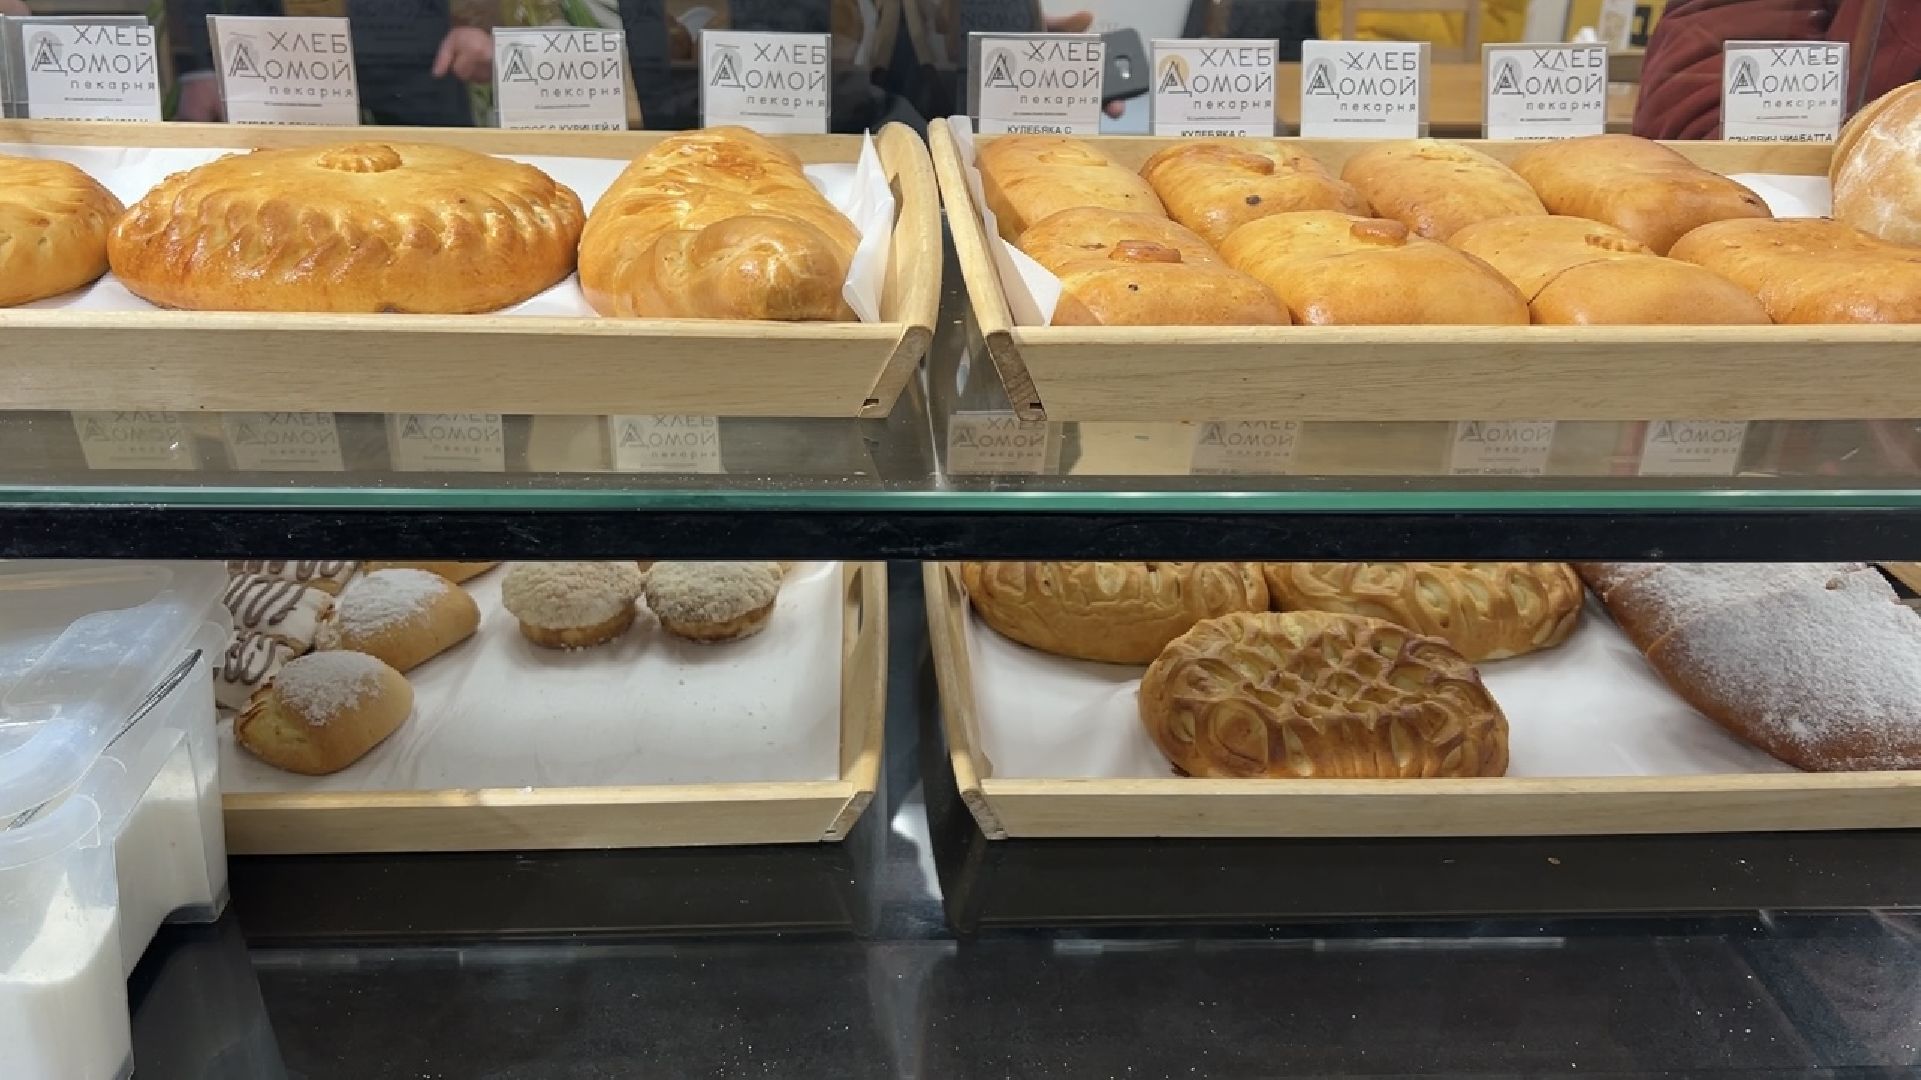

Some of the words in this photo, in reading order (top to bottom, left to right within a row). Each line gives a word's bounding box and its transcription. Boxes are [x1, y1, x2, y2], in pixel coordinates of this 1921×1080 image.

[73, 25, 152, 46] ХЛЕБ
[267, 31, 348, 53] ХЛЕБ
[543, 32, 618, 52] ХЛЕБ
[31, 36, 154, 77] ДОМОЙ
[753, 42, 826, 64] ХЛЕБ
[1028, 41, 1101, 61] ХЛЕБ
[1200, 48, 1272, 67] ХЛЕБ
[1346, 51, 1416, 70] ХЛЕБ
[1533, 49, 1602, 68] ХЛЕБ
[1771, 47, 1839, 66] ХЛЕБ
[228, 43, 351, 82] ДОМОЙ
[502, 48, 620, 85] ДОМОЙ
[710, 53, 826, 91] ДОМОЙ
[984, 53, 1100, 91] ДОМОЙ
[71, 80, 155, 94] пекарня
[1158, 61, 1272, 97] ДОМОЙ
[1306, 64, 1416, 99] ДОМОЙ
[1493, 61, 1602, 98] ДОМОЙ
[1729, 60, 1839, 97] ДОМОЙ
[269, 86, 354, 98] пекарня
[541, 88, 621, 99] пекарня
[1020, 96, 1099, 107] пекарня
[745, 96, 826, 109] пекарня
[1194, 100, 1272, 111] пекарня
[1340, 103, 1416, 114] пекарня
[1526, 102, 1601, 111] пекарня
[1007, 125, 1062, 135] КУЛЕБЯКА
[620, 424, 717, 448] ДОМОЙ
